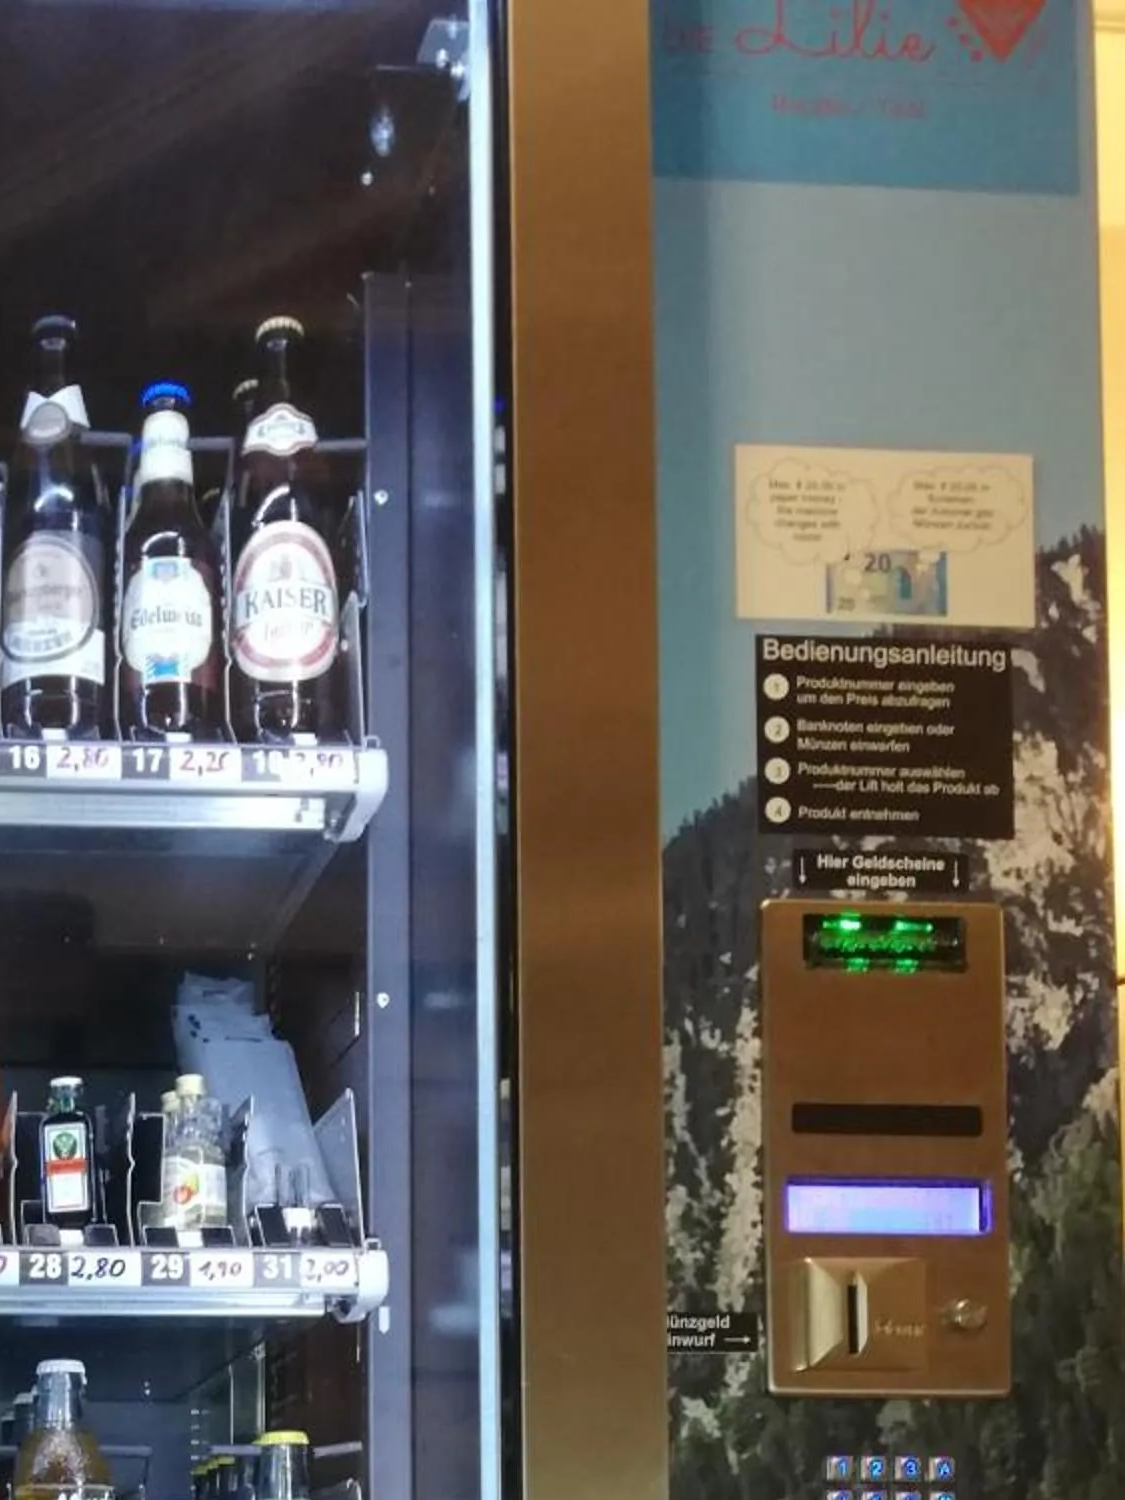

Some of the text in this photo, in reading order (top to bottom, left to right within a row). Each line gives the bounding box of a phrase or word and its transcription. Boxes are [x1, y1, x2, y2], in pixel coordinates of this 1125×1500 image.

[865, 553, 892, 574] 20
[245, 587, 328, 619] KAISER
[763, 638, 1007, 671] Bedienungsanleitung
[796, 676, 955, 693] Produktnummer eingeben
[797, 693, 950, 709] um den Preis abzufragen
[797, 719, 864, 733] Banknoten
[866, 722, 924, 736] eingeben
[926, 723, 955, 735] oder
[797, 736, 911, 753] Münzen einwerfen
[9, 745, 41, 769] 16
[132, 747, 163, 773] 17
[798, 762, 896, 777] Produktnummer
[899, 766, 966, 779] auswählen
[859, 781, 879, 793] Lift
[881, 781, 905, 793] holt
[907, 783, 930, 794] das
[933, 782, 981, 796] Produkt
[984, 784, 1000, 796] ab
[798, 806, 846, 819] Produkt
[849, 808, 920, 821] entnehmen
[817, 853, 946, 871] Hier Geldscheine
[846, 872, 917, 889] eingeben
[29, 1254, 62, 1280] 28
[151, 1254, 185, 1280] 29
[262, 1255, 293, 1280] 31
[668, 1314, 730, 1331] ünzgeld
[668, 1332, 716, 1347] inwurf
